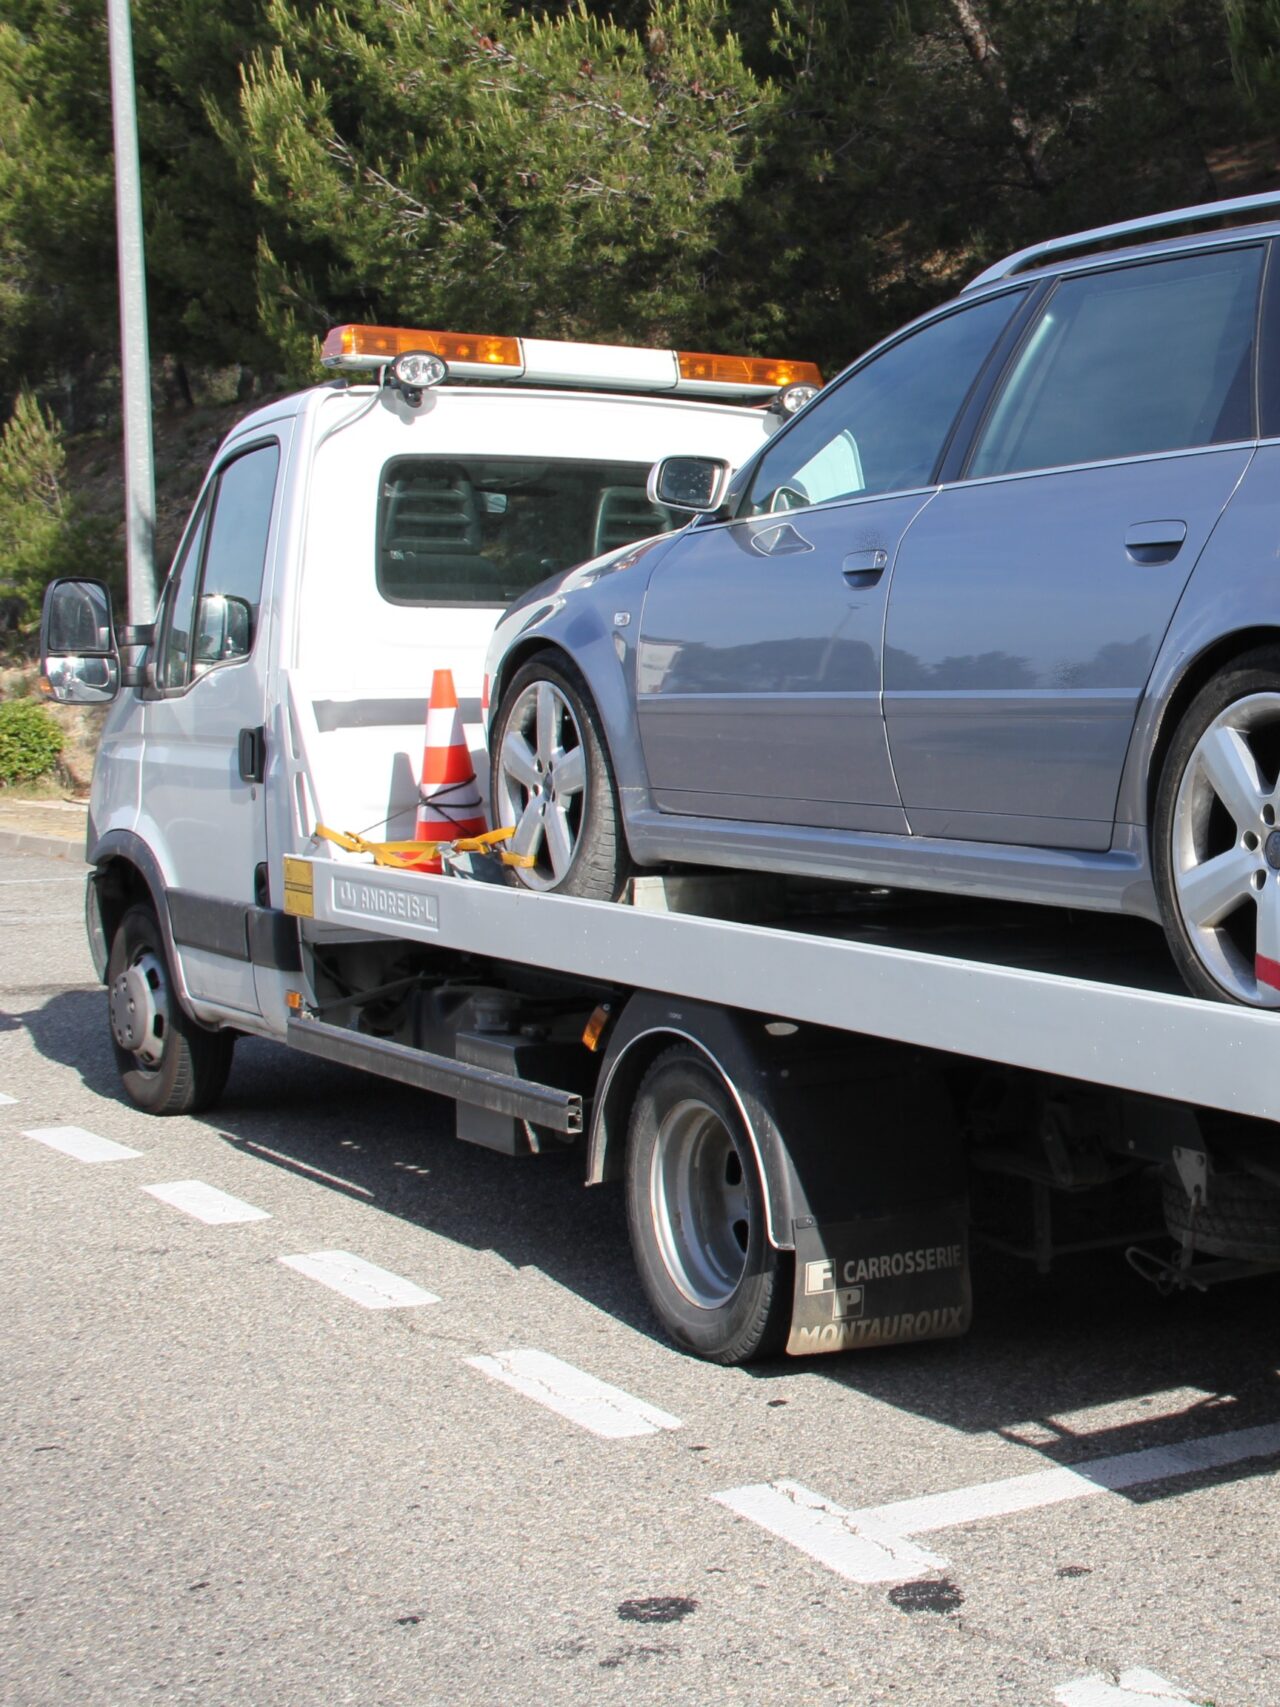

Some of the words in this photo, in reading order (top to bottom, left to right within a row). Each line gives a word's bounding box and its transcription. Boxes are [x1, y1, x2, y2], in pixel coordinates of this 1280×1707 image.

[808, 1262, 833, 1291] F
[843, 1245, 961, 1283] CARROSSERIE
[836, 1289, 861, 1318] P
[800, 1306, 964, 1347] MONTAUROUX
